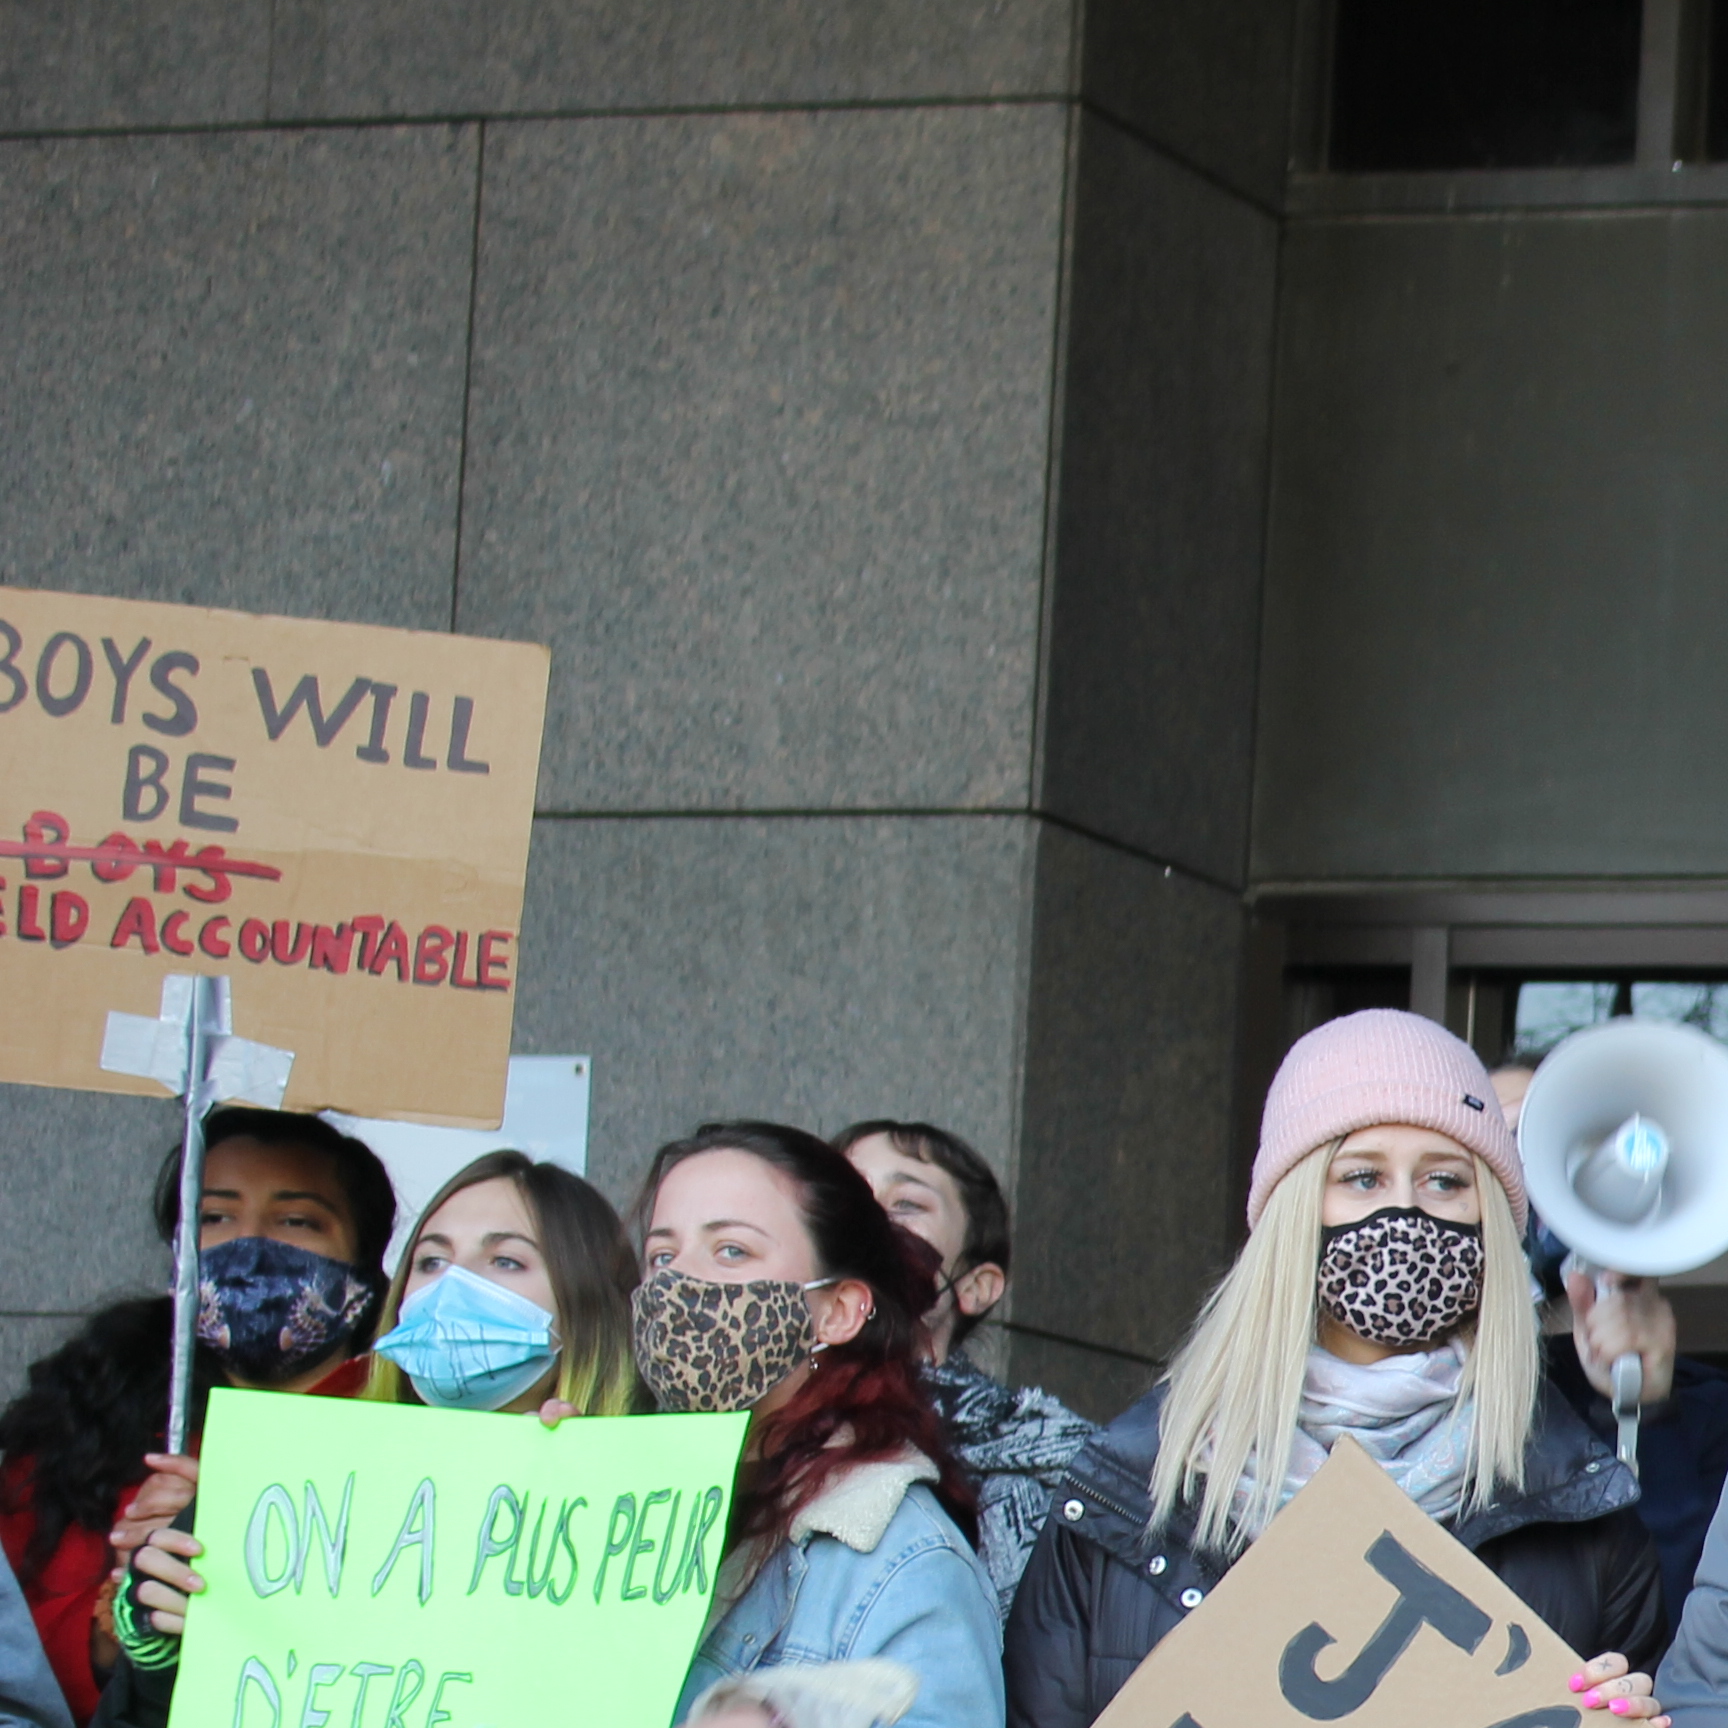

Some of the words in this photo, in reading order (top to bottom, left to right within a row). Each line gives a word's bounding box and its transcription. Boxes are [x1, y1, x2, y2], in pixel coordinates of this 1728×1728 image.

[251, 666, 491, 775] WILL
[121, 743, 240, 834] BE
[110, 895, 515, 992] ACCOUNTABLE
[244, 1471, 356, 1600] ON
[370, 1477, 436, 1606] A
[466, 1483, 586, 1606] PLUS
[593, 1485, 726, 1606] PEUR
